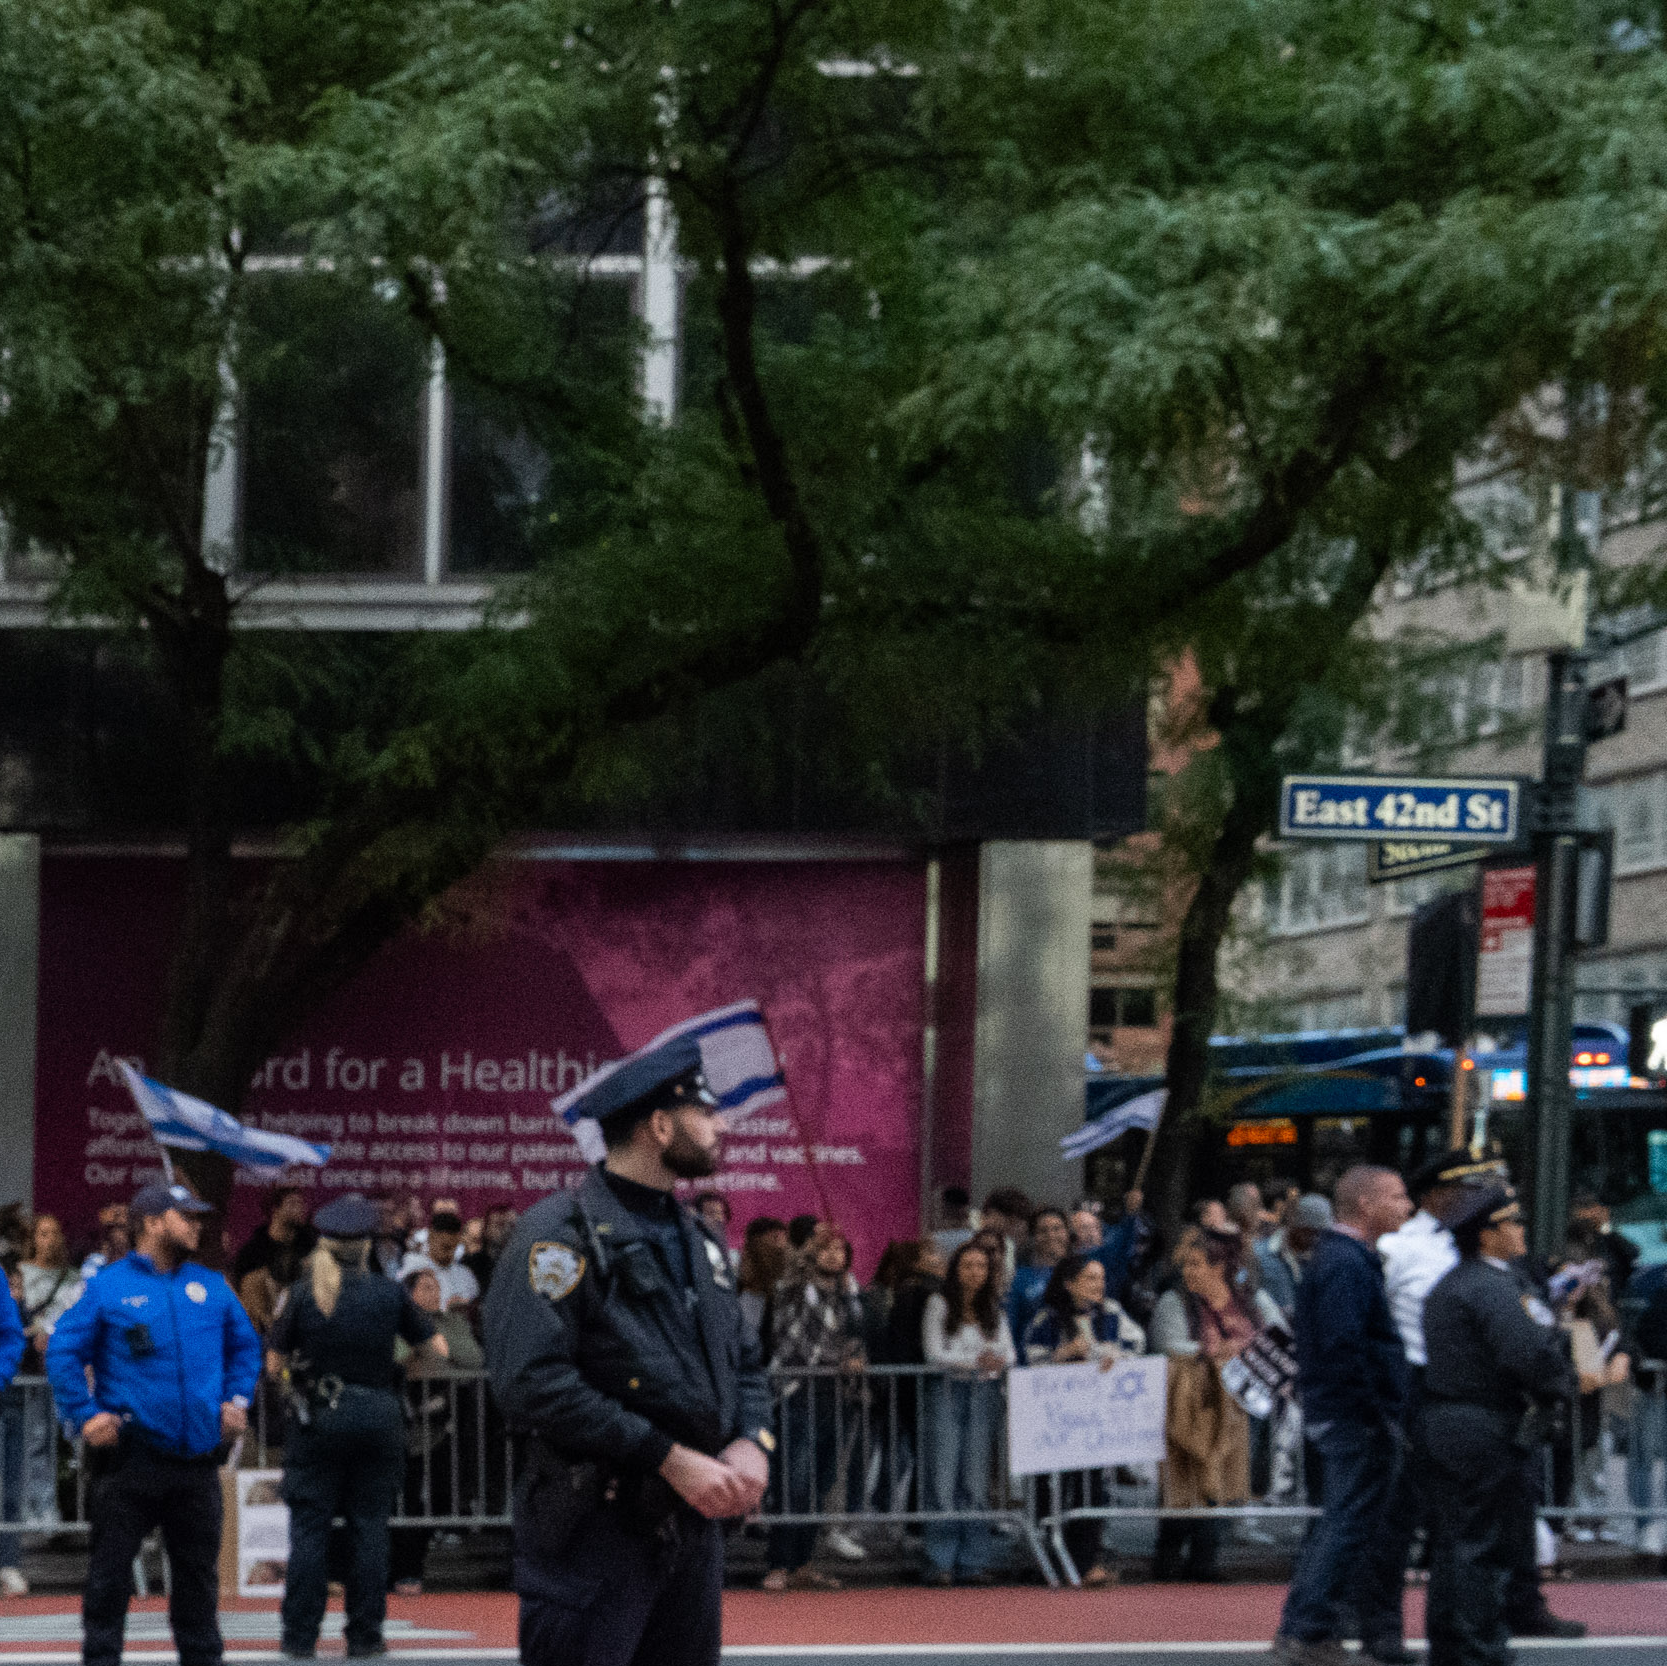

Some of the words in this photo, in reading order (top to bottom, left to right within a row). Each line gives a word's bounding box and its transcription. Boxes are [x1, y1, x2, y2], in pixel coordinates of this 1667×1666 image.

[1293, 789, 1370, 826] East
[1375, 793, 1460, 828] 42nd
[1466, 794, 1505, 831] St
[325, 1047, 388, 1091] for
[398, 1057, 426, 1092] a
[439, 1050, 613, 1093] Healthi
[348, 1112, 371, 1134] to
[376, 1110, 438, 1133] break
[443, 1112, 505, 1134] down
[369, 1143, 437, 1162] access
[443, 1142, 466, 1161] to
[469, 1145, 508, 1162] our
[724, 1142, 767, 1163] and
[770, 1143, 866, 1164] vacines.
[83, 1162, 128, 1187] Our
[522, 1168, 560, 1190] but
